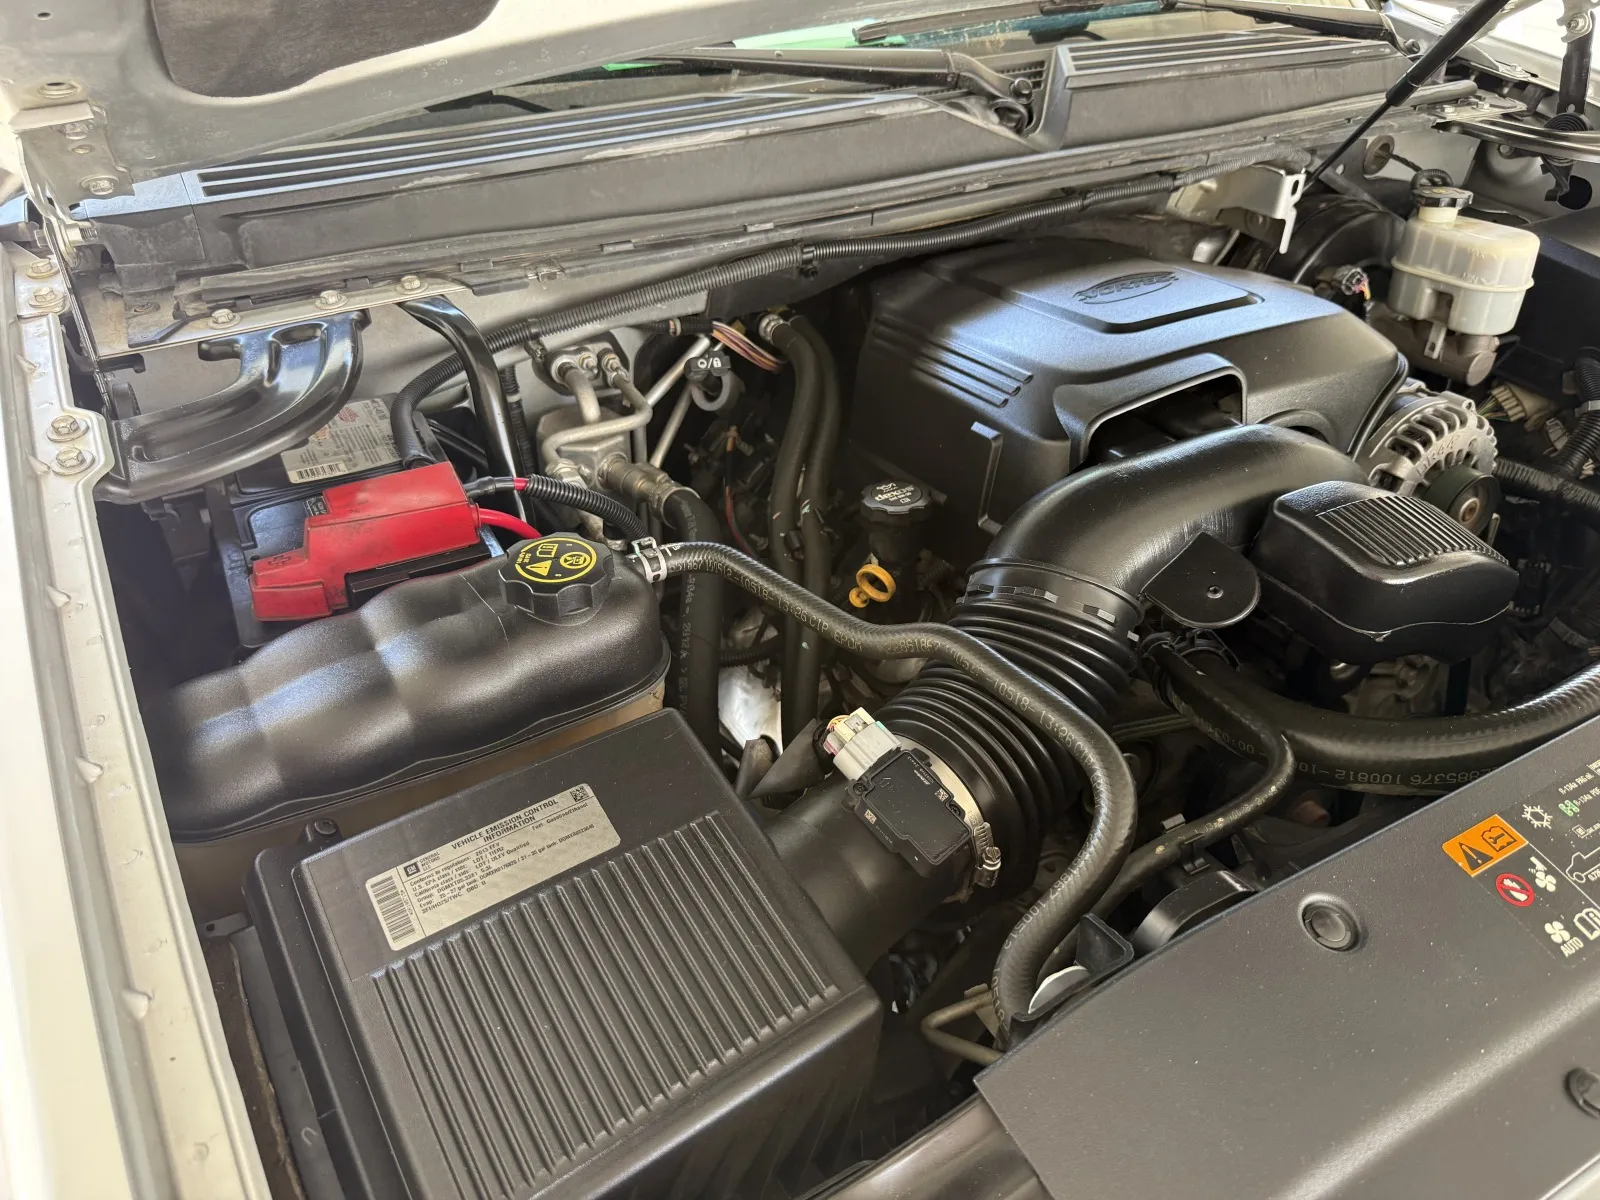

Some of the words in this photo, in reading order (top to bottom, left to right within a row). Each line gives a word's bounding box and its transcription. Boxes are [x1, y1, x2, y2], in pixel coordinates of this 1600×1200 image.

[1075, 274, 1179, 301] VORTEC
[874, 486, 914, 501] dexos
[809, 615, 829, 633] CIP
[1334, 769, 1402, 786] 100812
[452, 831, 485, 849] VEHICLE
[486, 815, 522, 834] EMISSION
[524, 799, 558, 817] CONTROL
[484, 815, 535, 842] INFORMATION
[476, 848, 488, 856] 2013
[438, 872, 450, 880] class
[441, 877, 453, 885] class
[1560, 936, 1584, 958] AUTO
